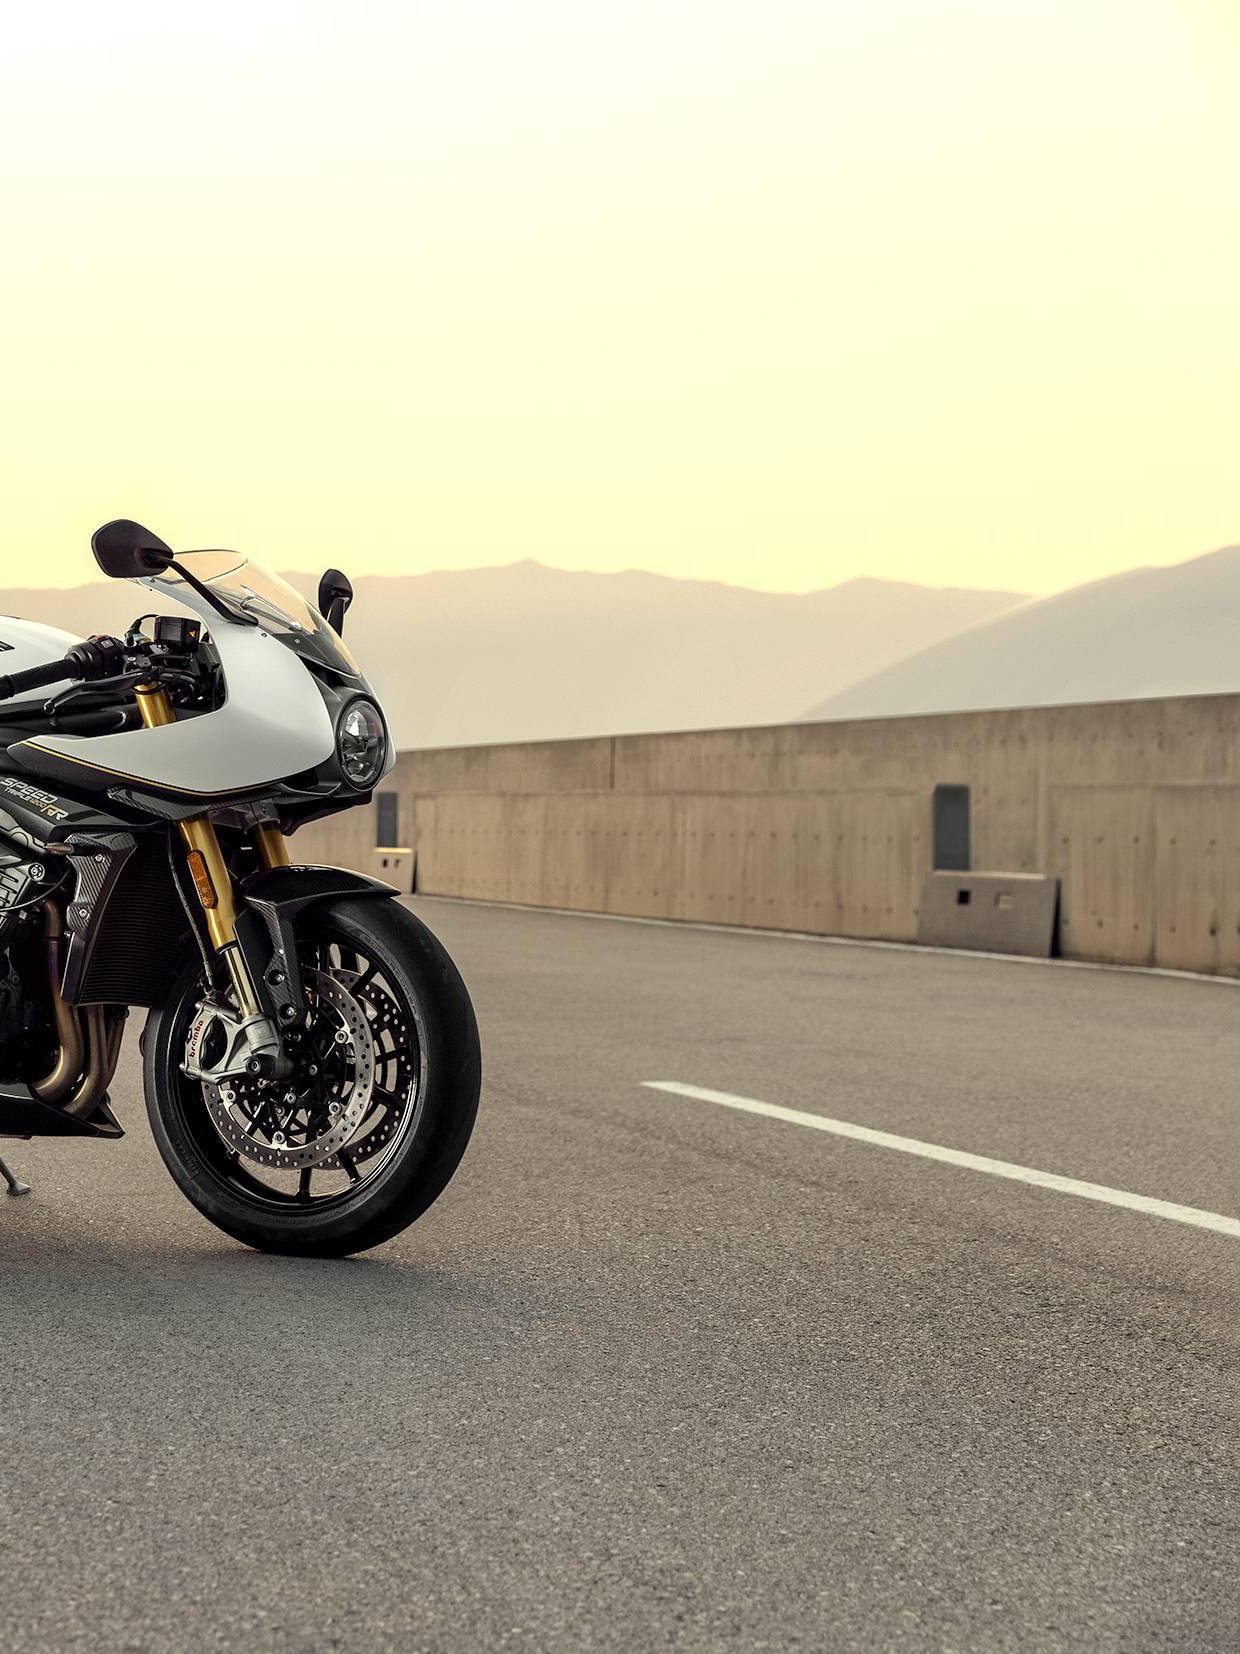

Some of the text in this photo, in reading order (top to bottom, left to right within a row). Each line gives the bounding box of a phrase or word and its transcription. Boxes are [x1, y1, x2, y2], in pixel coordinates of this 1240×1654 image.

[0, 777, 58, 804] SPEED
[4, 787, 31, 801] TRIPLE
[40, 804, 69, 821] RR
[188, 1020, 204, 1058] brembo
